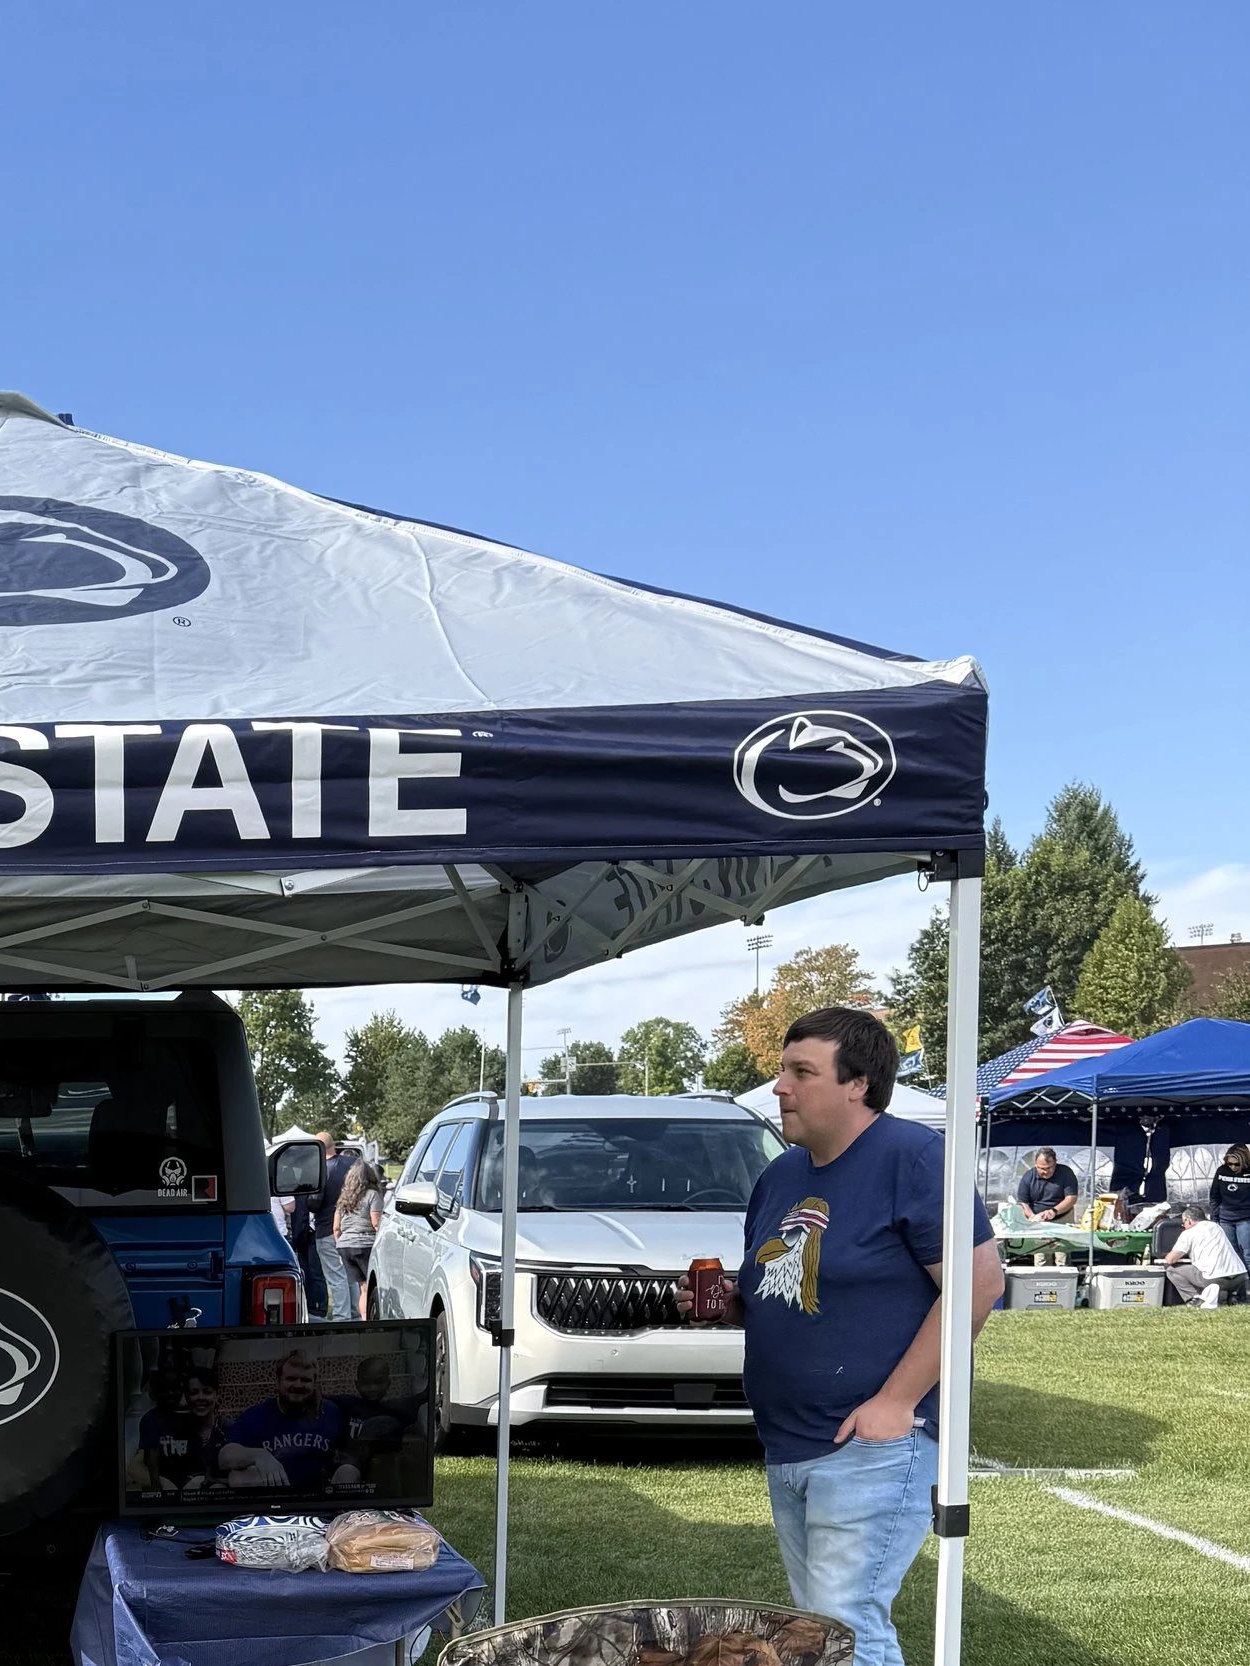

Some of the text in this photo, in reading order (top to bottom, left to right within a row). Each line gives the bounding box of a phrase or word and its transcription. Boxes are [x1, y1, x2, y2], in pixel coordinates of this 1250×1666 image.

[157, 1189, 187, 1197] DEAD AIR
[262, 1432, 330, 1452] RANGERS
